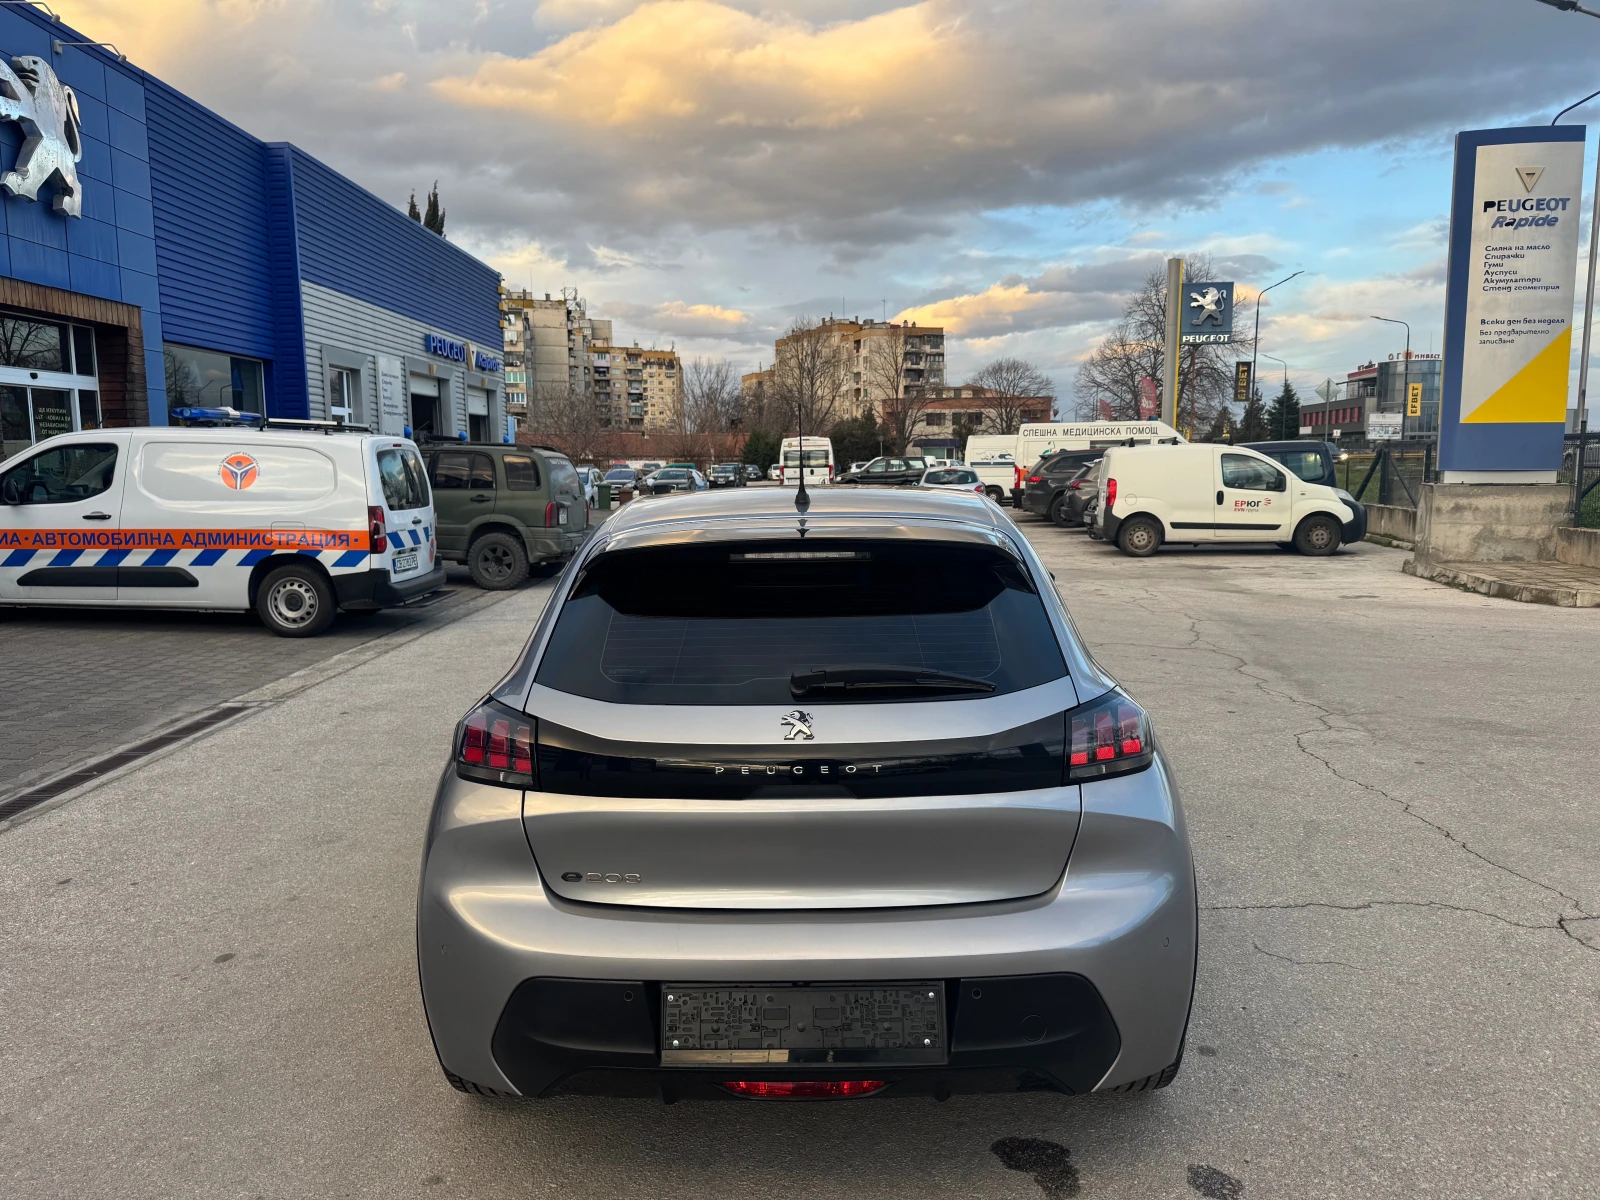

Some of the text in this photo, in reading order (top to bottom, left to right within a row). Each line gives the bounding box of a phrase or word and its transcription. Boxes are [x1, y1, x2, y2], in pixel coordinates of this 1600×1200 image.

[1483, 197, 1570, 213] PEUGEOT
[1491, 214, 1559, 230] Rapide
[1484, 252, 1525, 261] Спирачки
[1483, 261, 1504, 269] Гуми
[1483, 269, 1518, 277] Ауспуси
[1483, 277, 1541, 285] Акумулатори
[1480, 318, 1505, 326] Всеки
[1506, 318, 1521, 326] ден
[1493, 328, 1550, 336] предварително
[1182, 334, 1230, 343] PEUGEOT
[430, 334, 467, 363] PEUGEOT
[1410, 385, 1419, 414] EFBET
[1022, 426, 1159, 437] СПЕШНА МЕДИЦИНСКА ПОМОЩ
[32, 532, 176, 546] АВТОМОБИЛНА
[181, 532, 350, 548] АДМИНИСТРАЦИЯ
[715, 764, 882, 775] PEUGEOT
